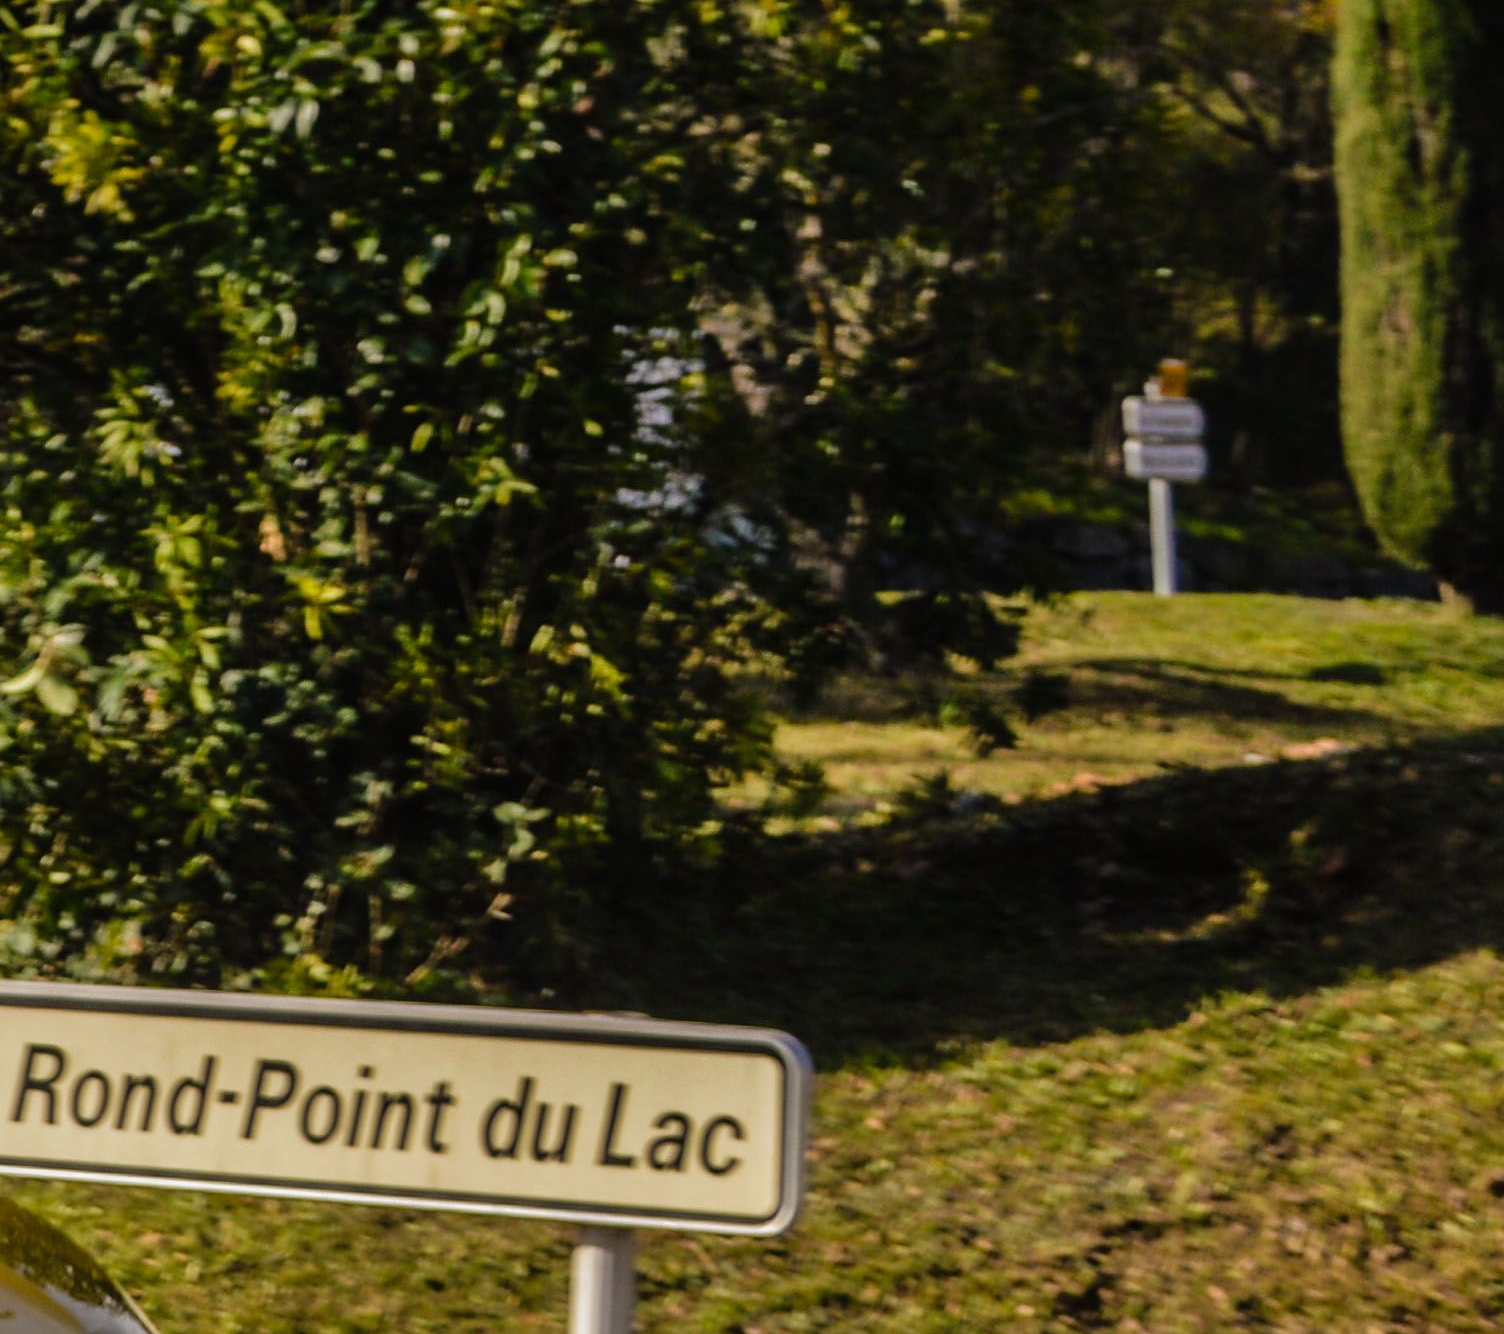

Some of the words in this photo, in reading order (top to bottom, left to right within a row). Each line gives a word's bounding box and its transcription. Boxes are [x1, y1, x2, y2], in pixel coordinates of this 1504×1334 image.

[9, 1041, 459, 1155] Rond-Point
[478, 1074, 581, 1165] du
[595, 1080, 748, 1178] Lac
